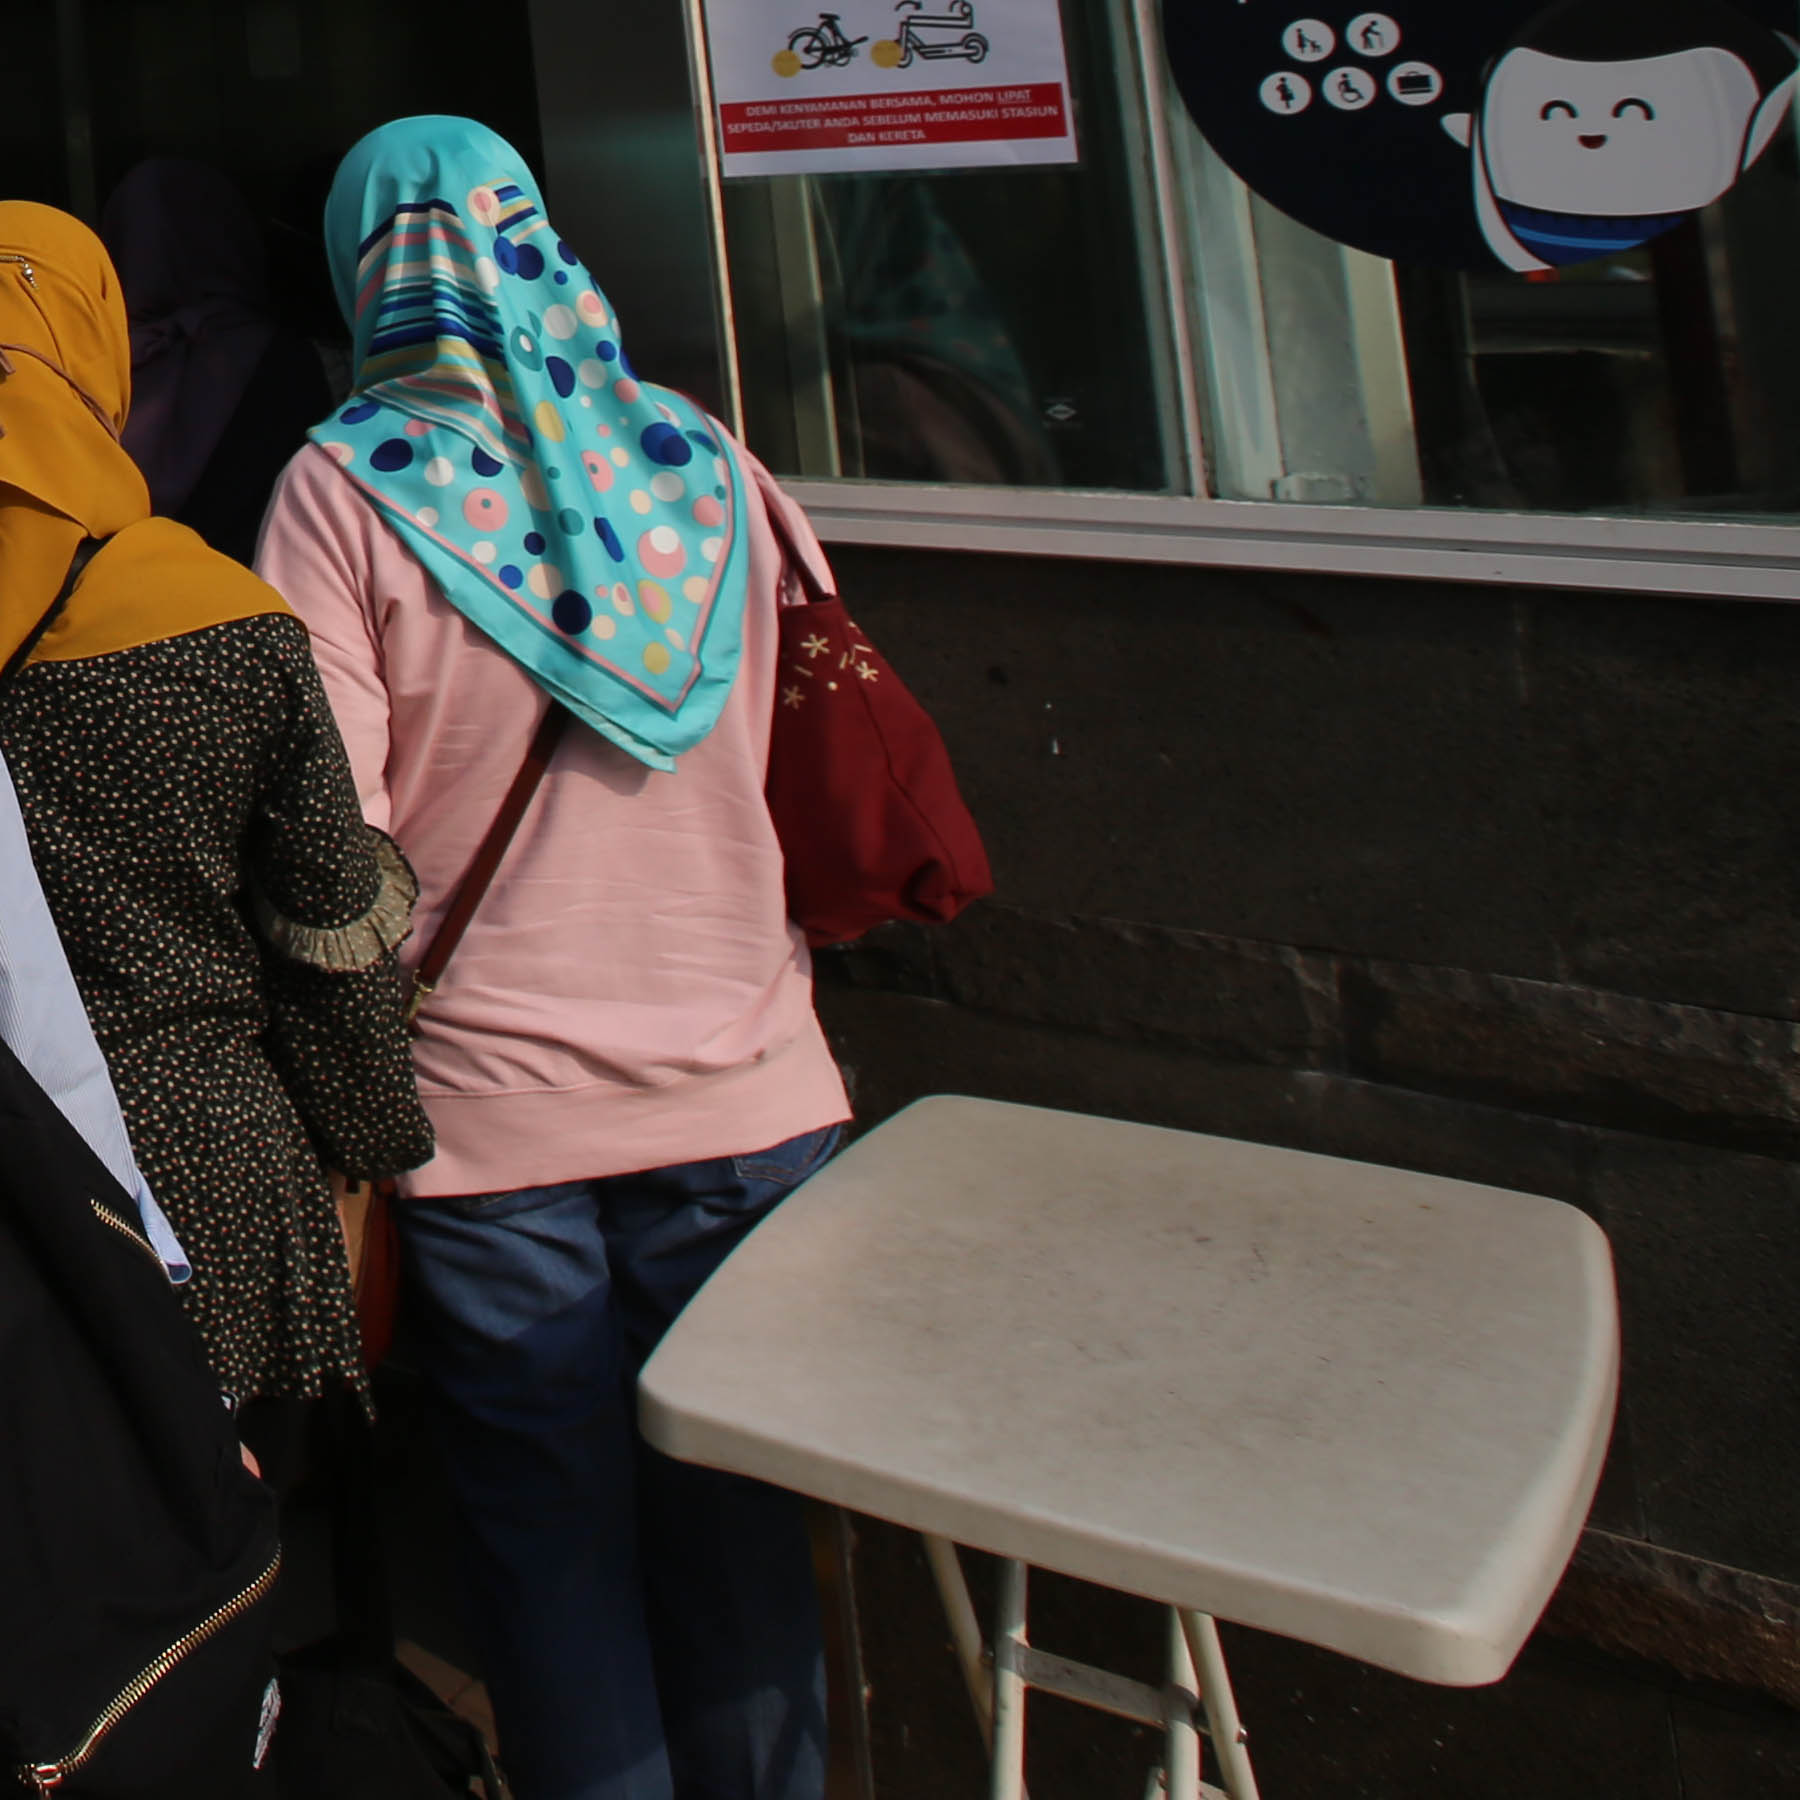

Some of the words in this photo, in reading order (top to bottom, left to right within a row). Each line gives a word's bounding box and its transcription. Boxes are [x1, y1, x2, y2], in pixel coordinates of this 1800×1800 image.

[746, 106, 777, 116] DEMI
[779, 100, 867, 114] KENYAMANAN
[870, 96, 936, 109] BERSAMA,
[939, 93, 993, 104] MOHON
[997, 89, 1032, 103] LIPAT
[824, 117, 860, 128] ANDA
[862, 114, 921, 125] SEBELUM
[924, 109, 998, 122] MEMASUKI
[1001, 106, 1058, 118] STASIUN
[848, 133, 875, 143] DAN
[879, 130, 925, 141] KERETA
